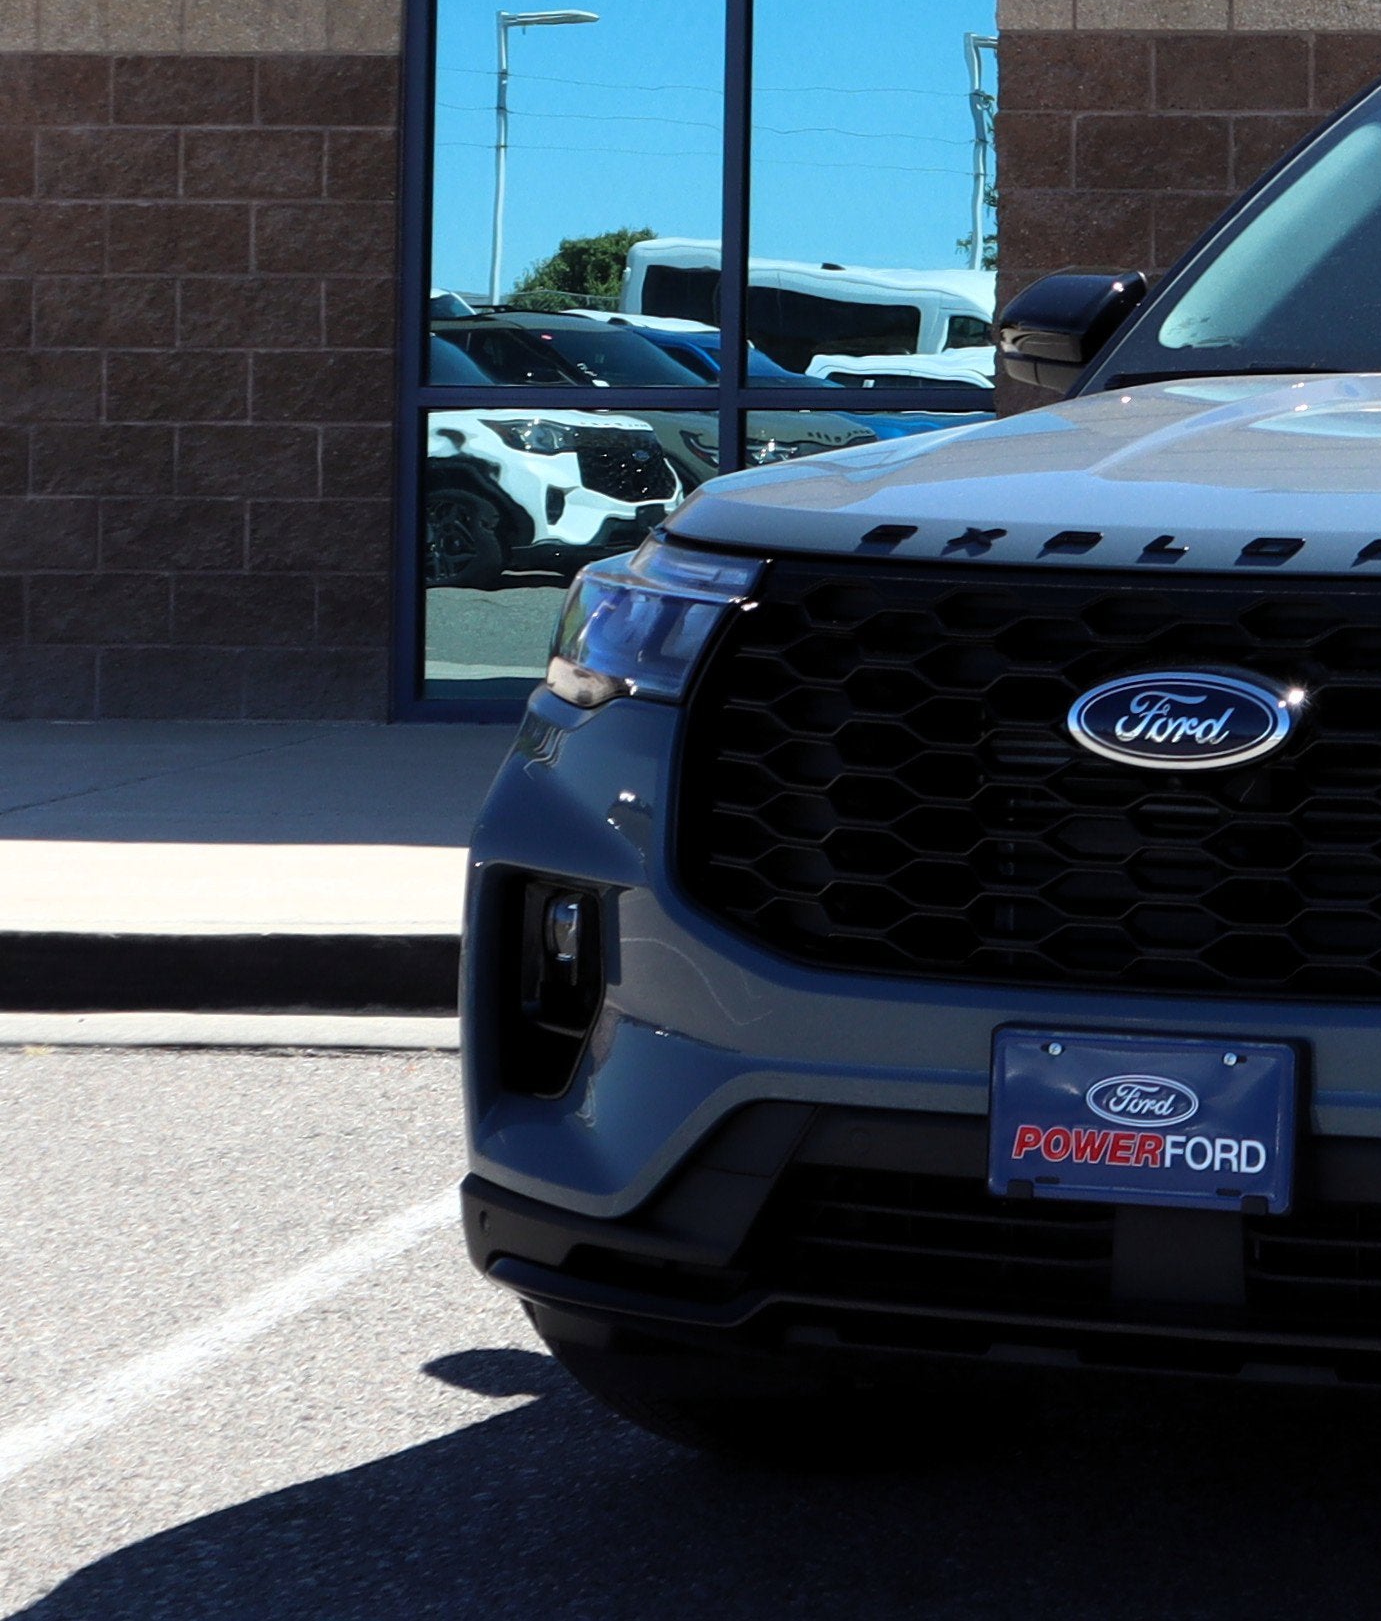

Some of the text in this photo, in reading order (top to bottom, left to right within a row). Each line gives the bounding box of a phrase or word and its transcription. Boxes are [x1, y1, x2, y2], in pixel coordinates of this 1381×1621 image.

[1114, 690, 1236, 745] Ford
[1109, 1083, 1175, 1116] Ford
[1012, 1125, 1267, 1173] POWERFORD
